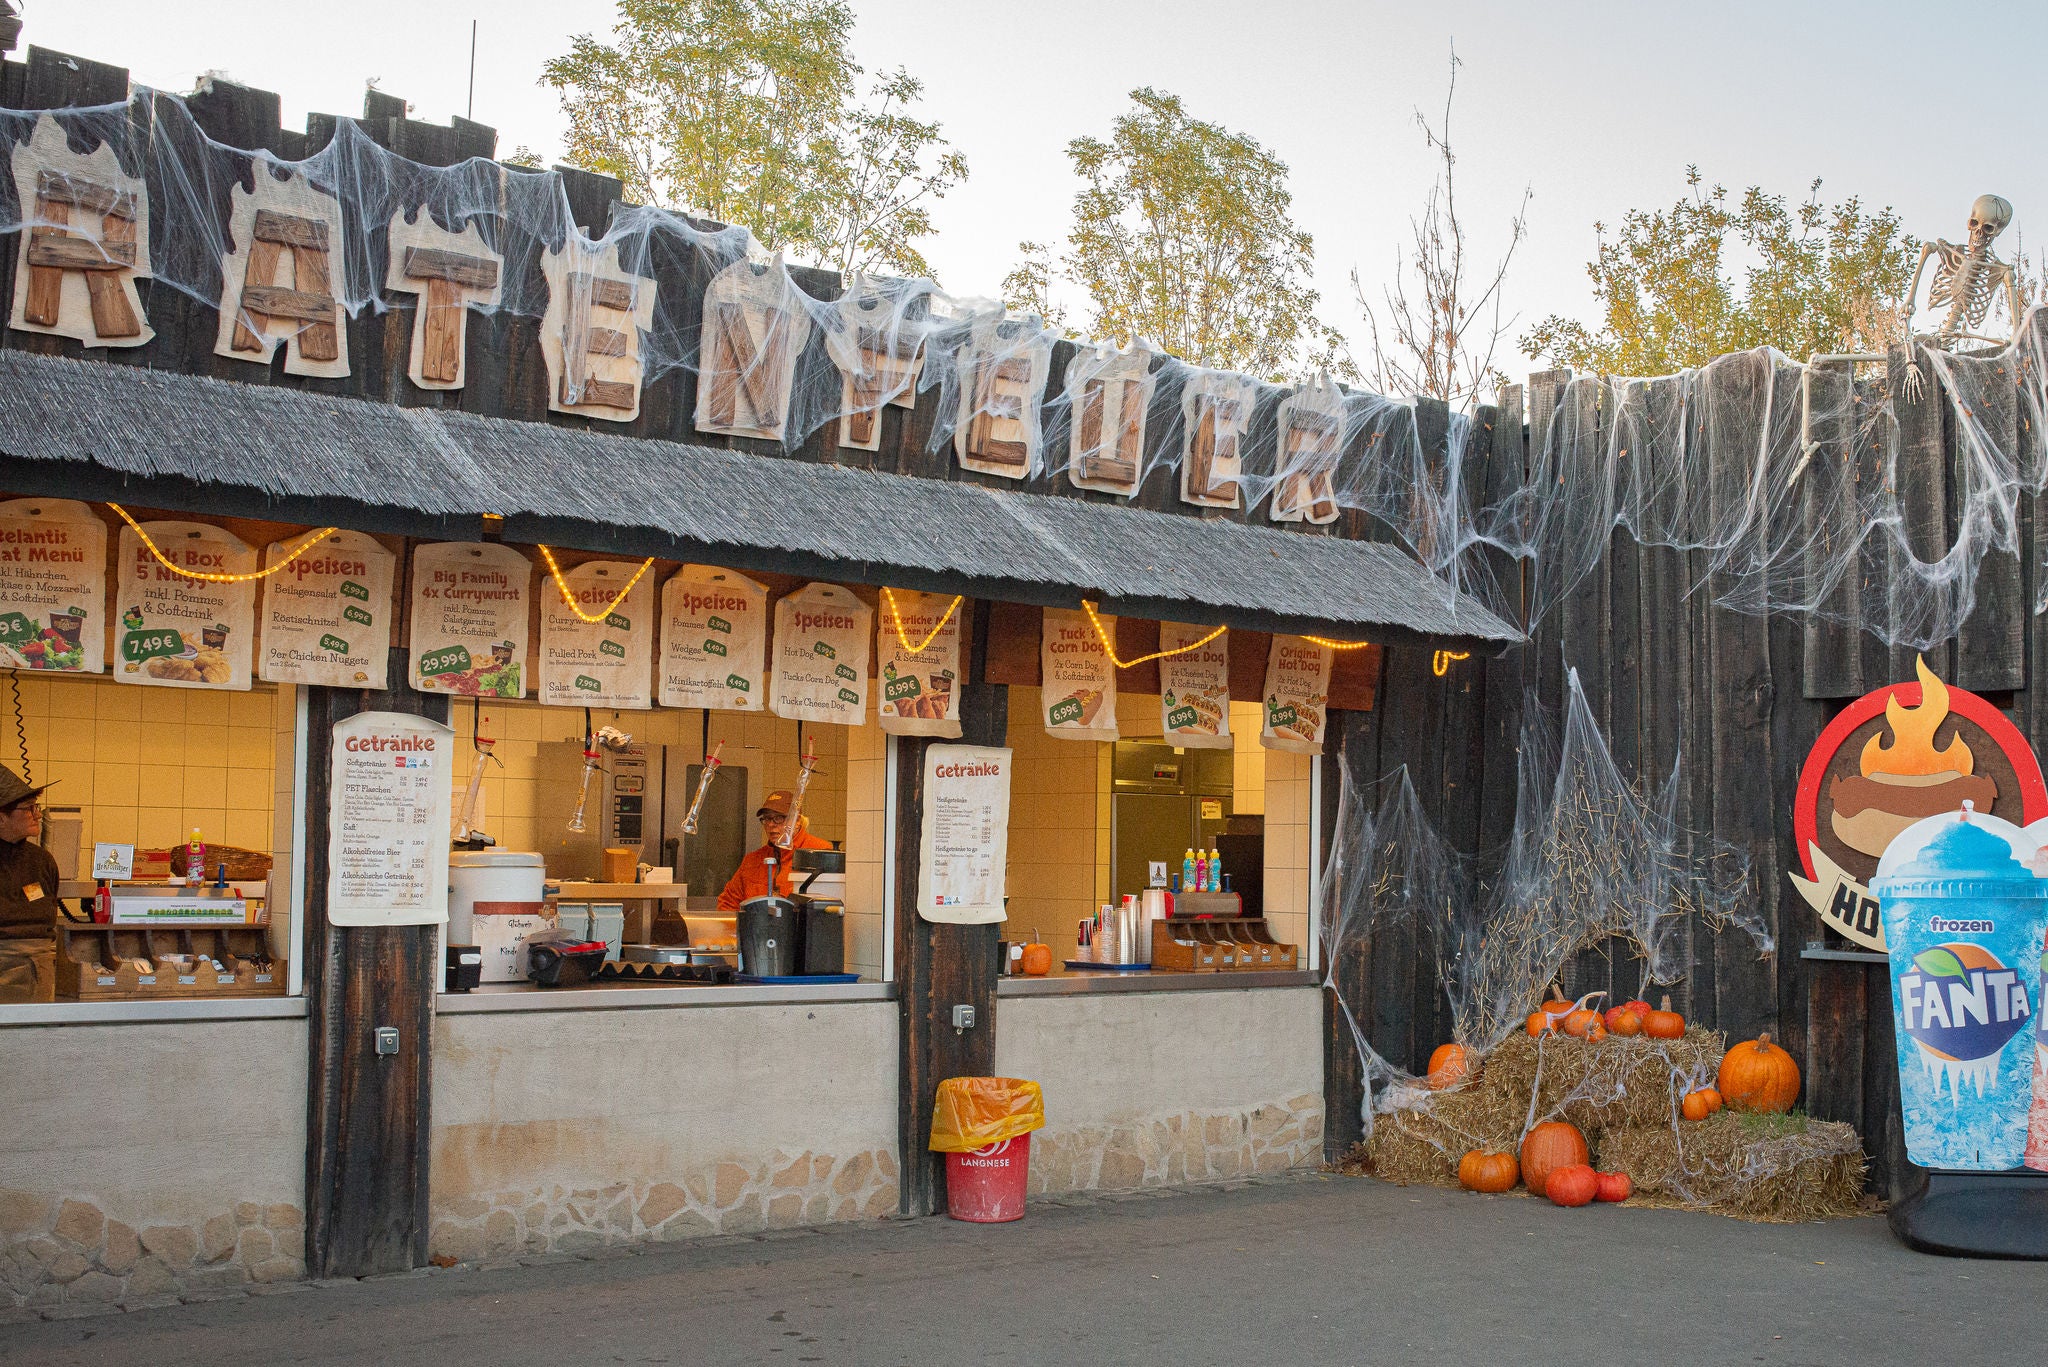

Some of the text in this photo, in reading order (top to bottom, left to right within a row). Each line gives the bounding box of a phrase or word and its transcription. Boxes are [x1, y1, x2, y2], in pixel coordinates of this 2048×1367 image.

[28, 547, 84, 562] Menü
[185, 551, 223, 567] Box
[137, 565, 149, 580] 5
[288, 556, 366, 581] Speisen
[0, 579, 23, 590] käse
[36, 582, 91, 594] Mozzarella
[434, 570, 508, 589] Big Family
[1, 592, 59, 604] & Softdrink
[144, 588, 224, 607] inkl. Pommes
[274, 584, 337, 598] Beilagensalat
[422, 586, 520, 605] 4x Currywurst
[683, 592, 747, 615] Speisen
[144, 602, 213, 620] & Softdrink
[273, 611, 339, 627] Röstischnitzel
[444, 615, 496, 628] Salatgarnitur
[672, 617, 704, 629] Pommes
[795, 611, 854, 633] Speisen
[883, 614, 957, 625] Rierliche Mhl
[440, 625, 448, 634] &
[461, 627, 498, 638] Softdrink
[884, 627, 955, 636] Hähchen Scitzel
[671, 642, 701, 655] Wedges
[784, 646, 814, 660] Hot Dog
[895, 640, 947, 653] in Pmmes
[1050, 641, 1105, 657] Corn Dog
[270, 647, 369, 667] 9er Chicken Nuggets
[549, 648, 597, 660] Pulled Pork
[895, 651, 941, 665] & Softdrink
[1203, 651, 1225, 667] Dog
[1280, 646, 1320, 663] Original
[1055, 659, 1099, 672] 2x Corn Dog
[1278, 659, 1320, 676] Hot Dog
[668, 675, 724, 689] Minikartoffeln
[805, 673, 824, 684] Corn
[825, 676, 840, 687] Dog
[1055, 671, 1061, 680] &
[1062, 671, 1095, 681] Softdrink
[1204, 670, 1218, 682] Dog
[549, 682, 571, 692] Salat
[1178, 679, 1208, 690] Softdrink
[803, 698, 829, 708] Cheese
[345, 734, 436, 752] Getränke
[346, 758, 387, 769] Softgetränke
[936, 762, 1000, 778] Getränke
[345, 783, 391, 794] PET Flaschen
[343, 823, 356, 831] Saft
[342, 848, 400, 856] Alkoholfreies Bier
[341, 872, 414, 880] Alkoholische Getränke
[1930, 916, 1994, 933] frozen
[515, 933, 526, 941] ode
[1900, 971, 2031, 1031] FANTA
[961, 1157, 1010, 1168] LANGNESE
